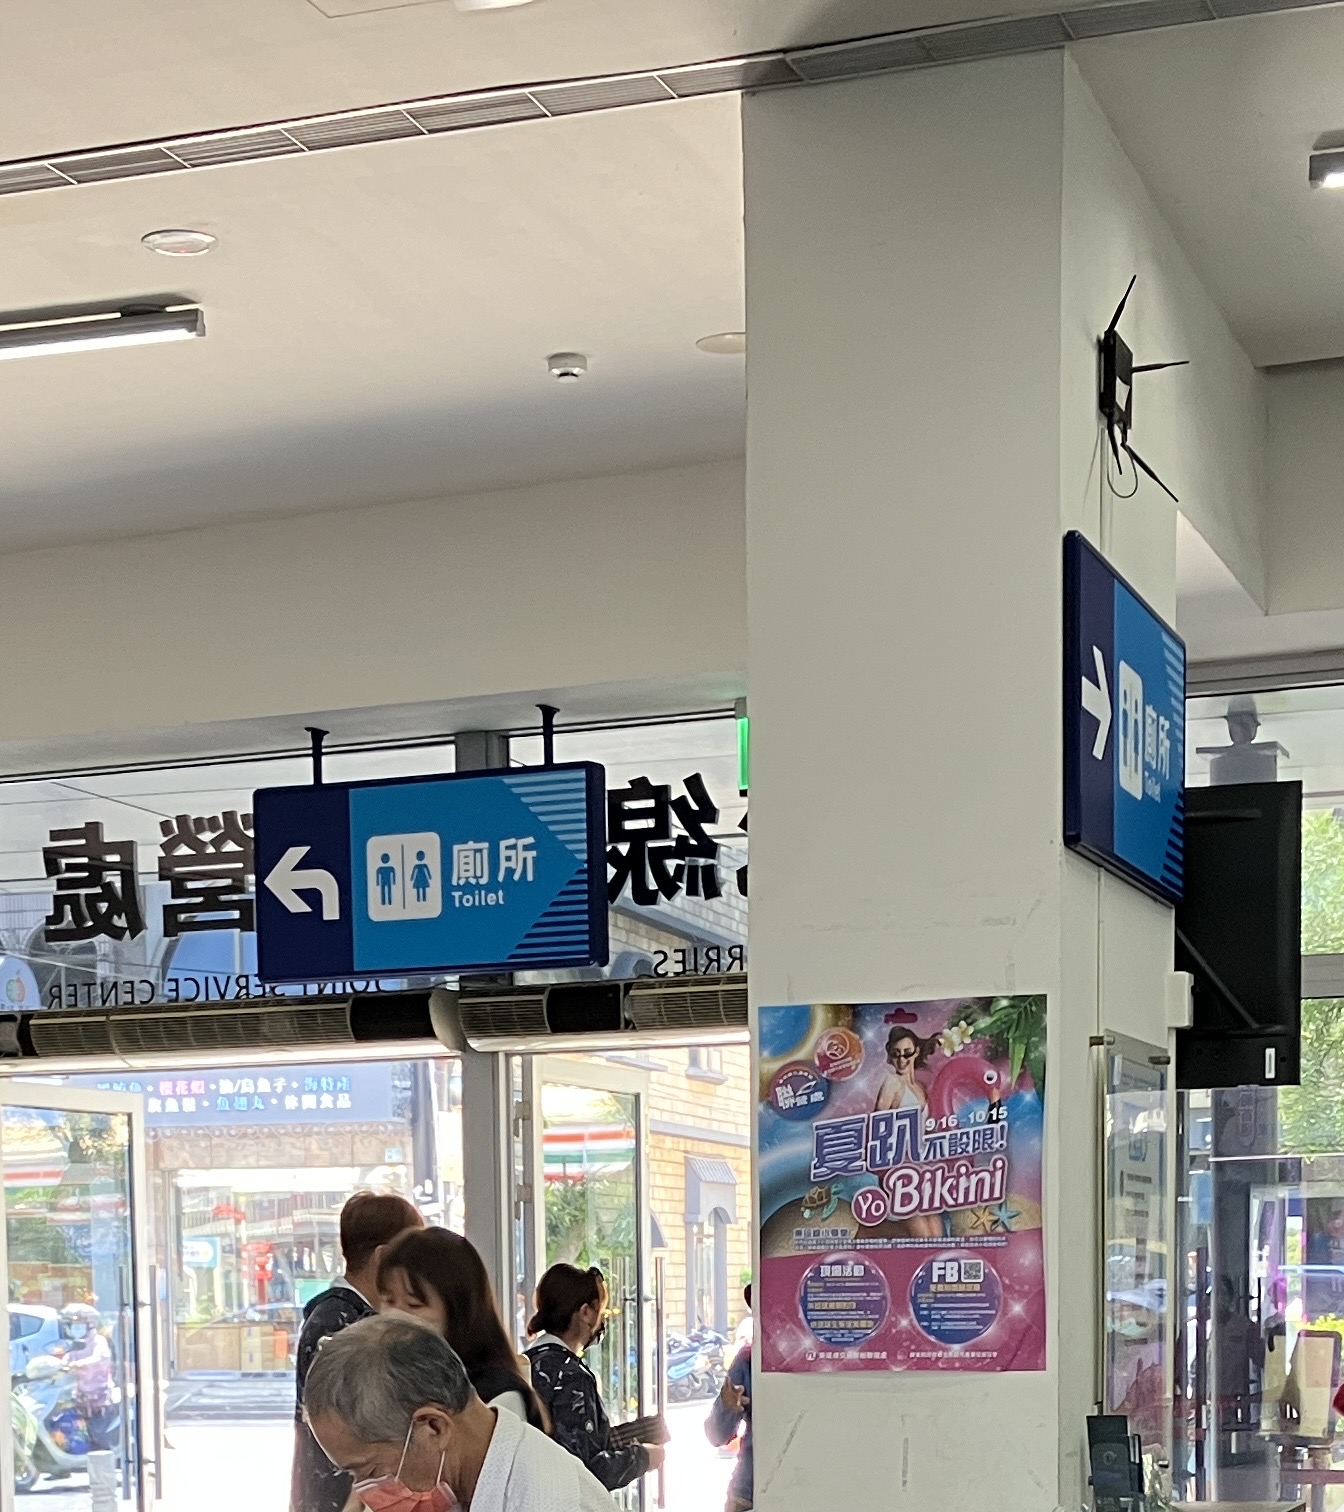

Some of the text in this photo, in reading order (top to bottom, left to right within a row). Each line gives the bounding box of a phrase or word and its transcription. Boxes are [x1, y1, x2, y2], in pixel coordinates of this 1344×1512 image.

[451, 836, 538, 886] 廁所
[451, 889, 505, 908] Toilet
[857, 1158, 1003, 1219] Yo Bikini
[932, 1261, 958, 1282] FB
